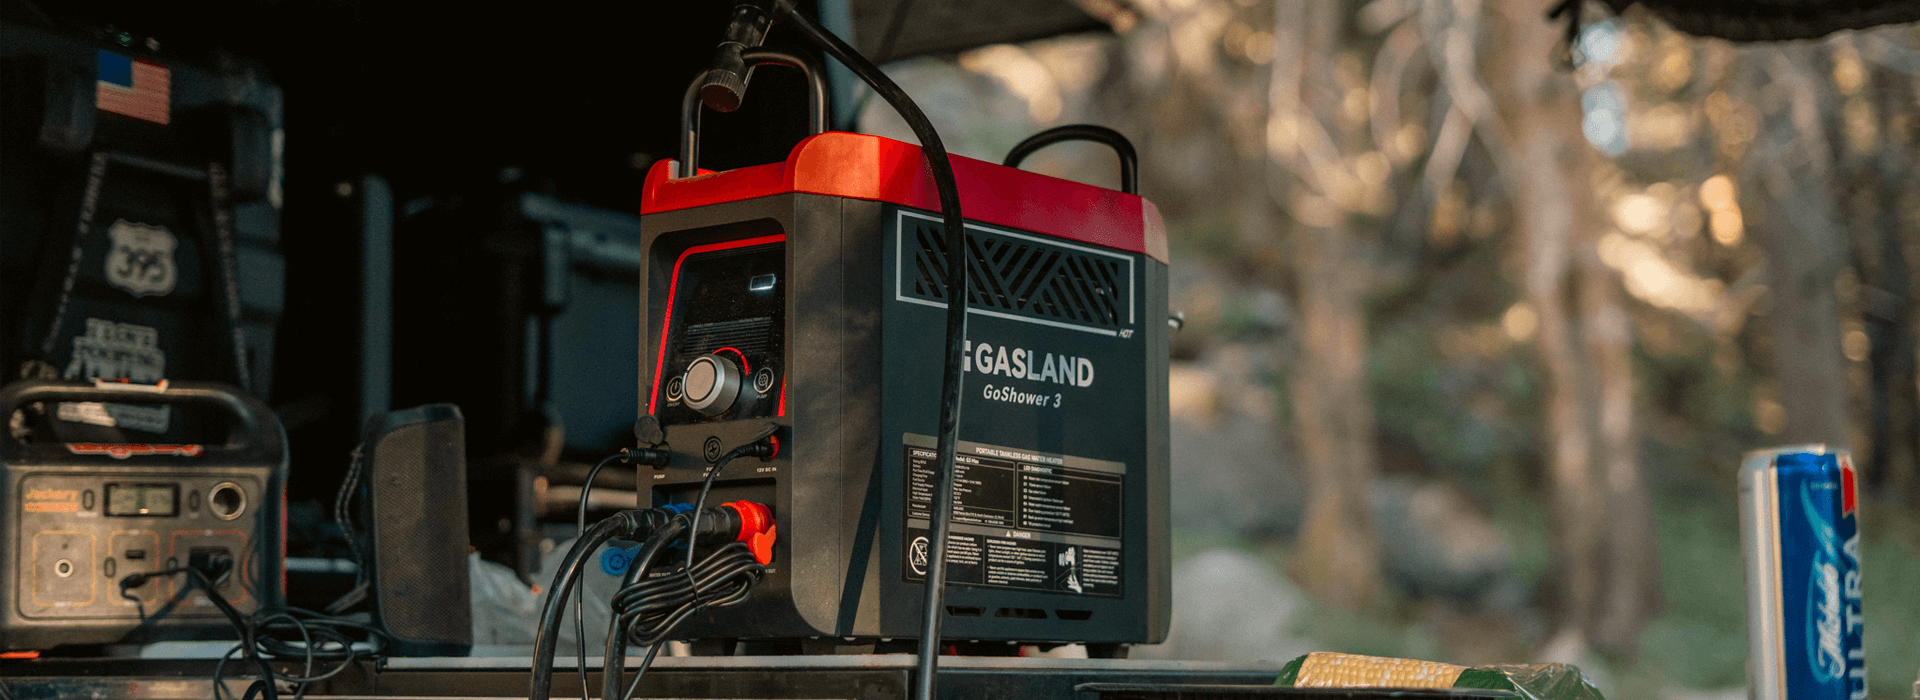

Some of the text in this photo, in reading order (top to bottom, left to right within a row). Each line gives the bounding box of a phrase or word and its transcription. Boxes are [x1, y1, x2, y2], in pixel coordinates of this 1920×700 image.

[116, 245, 167, 284] 395
[1118, 328, 1134, 338] HOT
[975, 342, 1094, 388] GASLAND
[983, 384, 1062, 409] GoShower 3
[976, 447, 1063, 465] PORTABLE TANKLESS GAS WATER HEATER
[1013, 531, 1031, 539] DANGER
[1842, 532, 1869, 700] ULTRA
